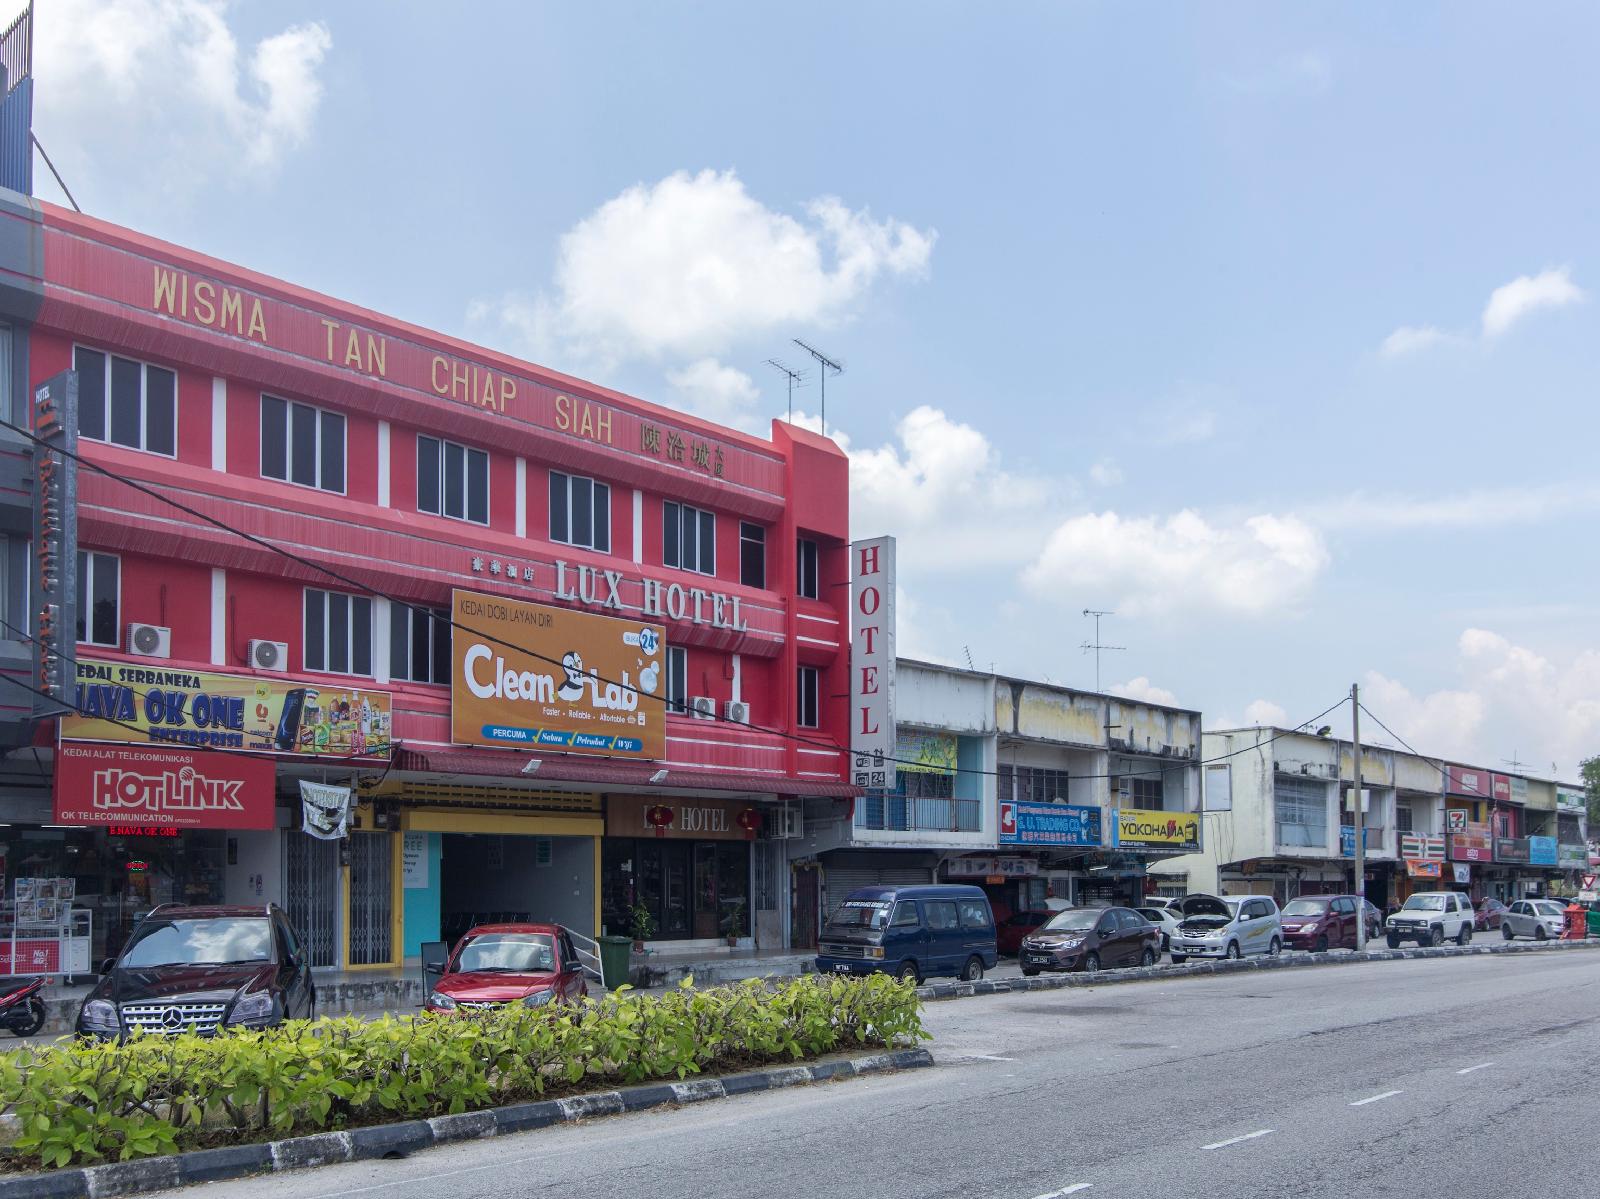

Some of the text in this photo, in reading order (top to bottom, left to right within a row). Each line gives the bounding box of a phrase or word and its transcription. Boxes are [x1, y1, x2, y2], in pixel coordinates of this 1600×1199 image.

[154, 266, 612, 444] WISMA TAN CHIAP SIAH
[35, 386, 50, 404] HOTEL
[555, 560, 747, 632] LUX HOTEL
[460, 600, 553, 628] KEDAI DOBI LAYAN DIRI
[642, 634, 654, 650] 24
[859, 545, 880, 735] HOTEL
[76, 664, 201, 689] EDAI SERBANEKA
[464, 643, 638, 711] Clean Lab
[144, 687, 188, 727] OK
[192, 692, 246, 730] ONE
[543, 706, 561, 717] Faster
[568, 709, 591, 720] Reliable
[493, 728, 527, 739] PERCUMA
[63, 747, 193, 763] KEDAI ALAT TELEKOMUNIKASI
[61, 811, 75, 820] OK
[78, 811, 174, 823] TELECOMMUNICATION
[681, 806, 730, 832] HOTEL
[1121, 820, 1184, 839] YOKOHAMA
